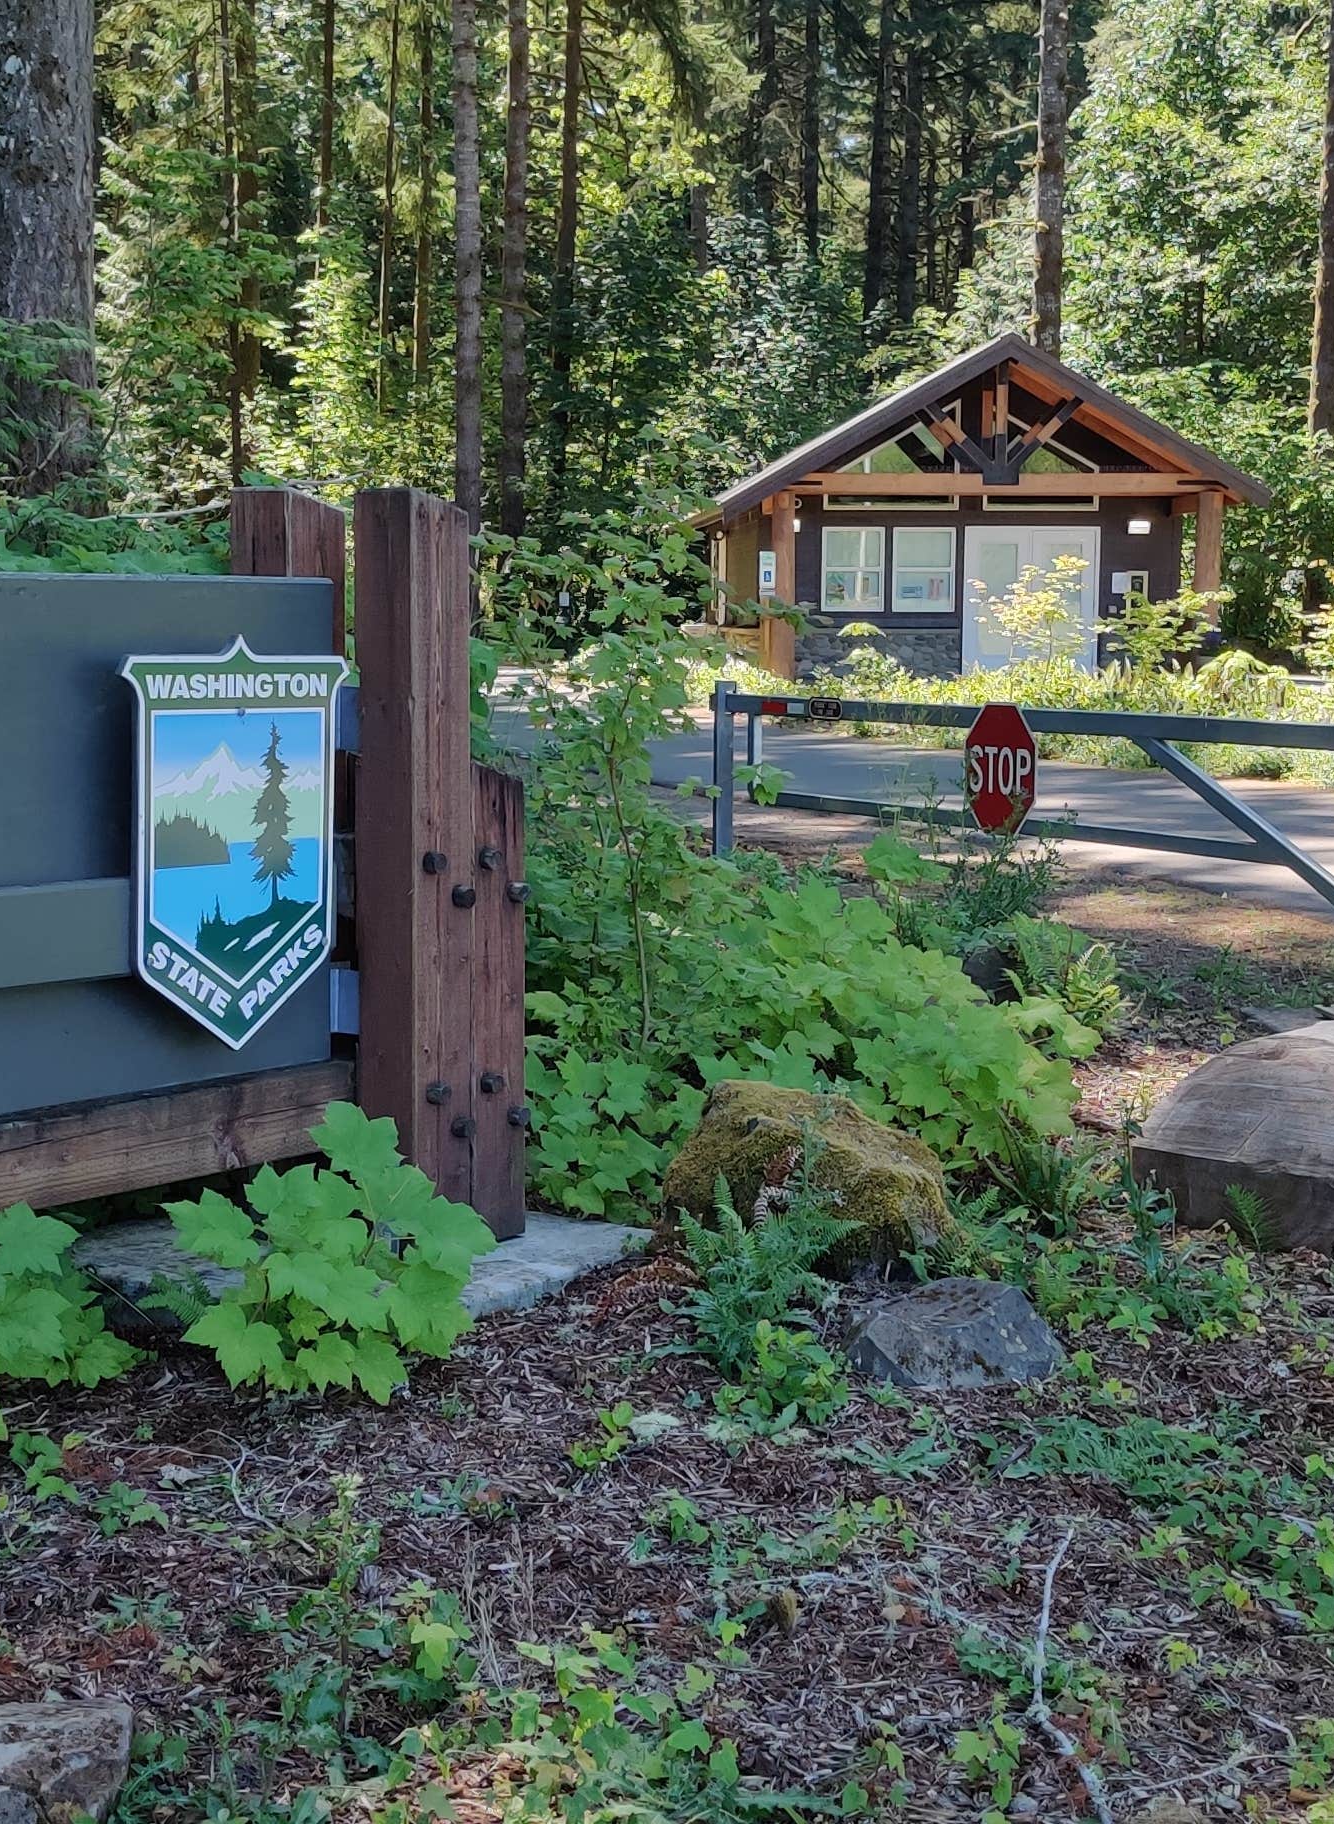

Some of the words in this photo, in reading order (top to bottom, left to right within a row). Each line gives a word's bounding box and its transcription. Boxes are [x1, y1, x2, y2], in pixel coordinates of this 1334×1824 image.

[145, 673, 327, 699] WASHINGTON
[969, 744, 1032, 795] STOP
[148, 941, 232, 1018] STATE
[238, 923, 323, 1020] PARKS
